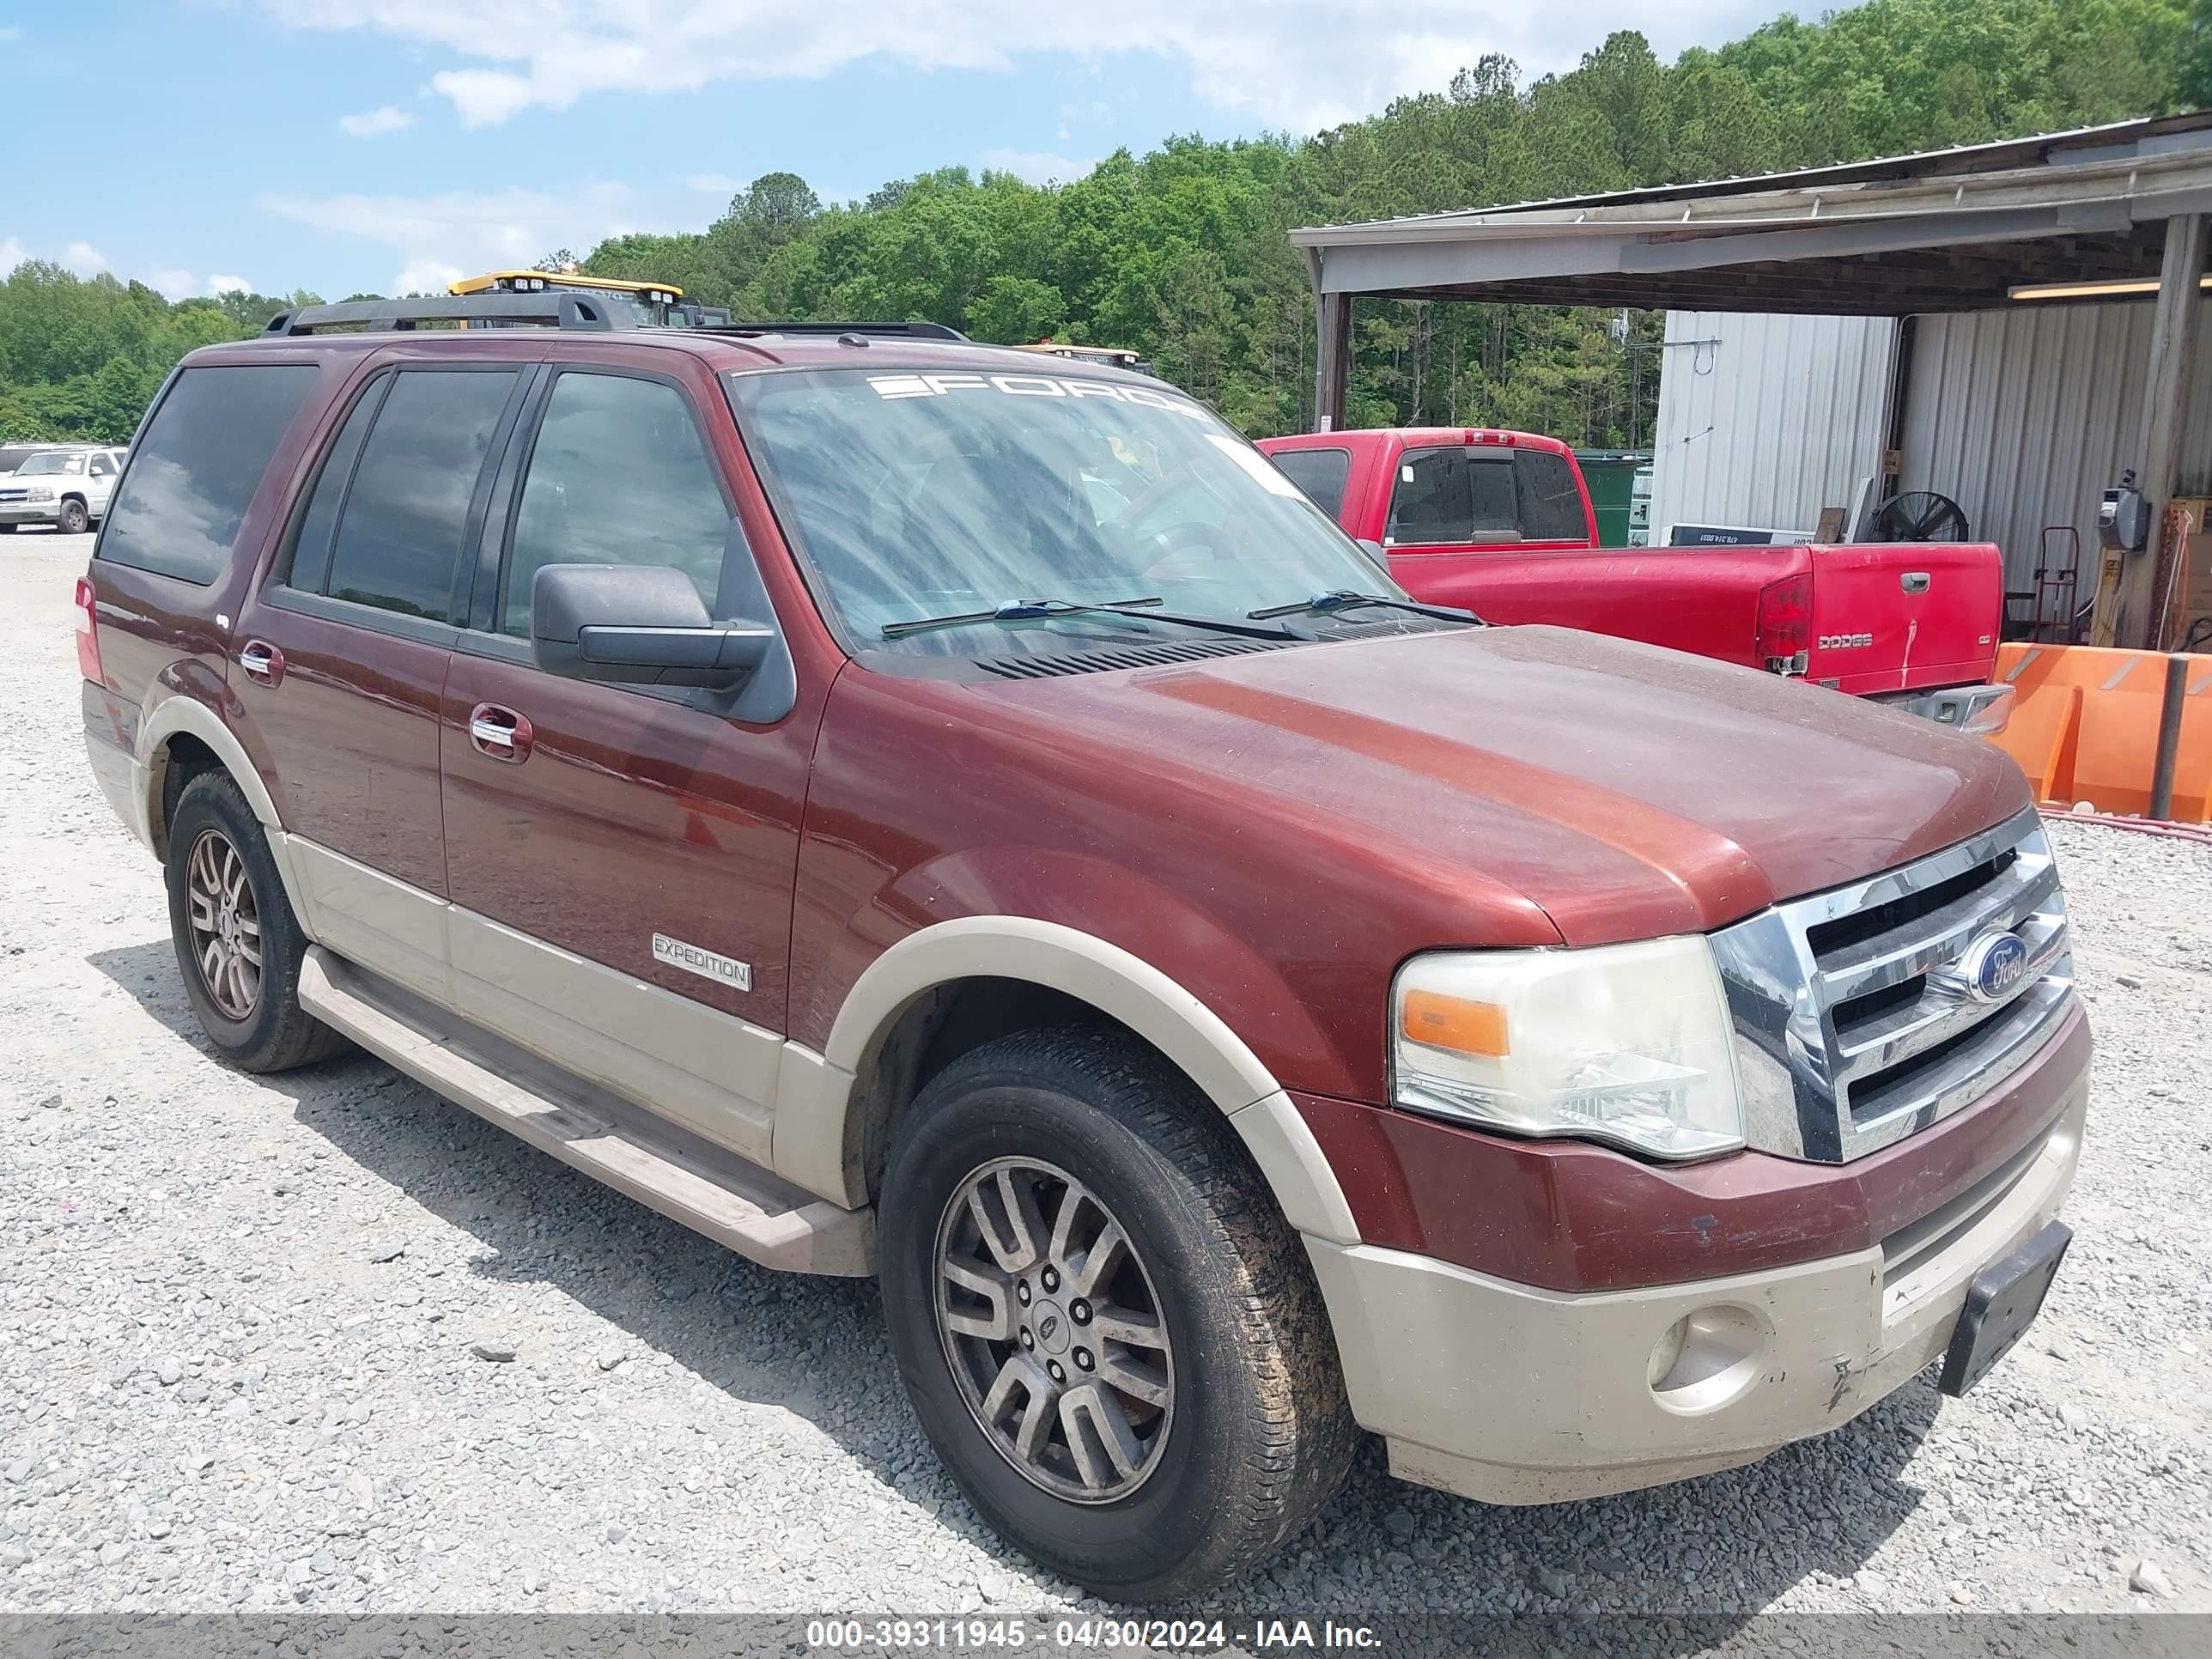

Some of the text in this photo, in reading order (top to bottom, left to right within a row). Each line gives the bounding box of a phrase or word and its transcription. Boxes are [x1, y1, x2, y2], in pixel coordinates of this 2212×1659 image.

[921, 375, 1178, 411] FORD
[1819, 633, 1873, 650] DODGE
[654, 938, 745, 981] EXPEDITION
[1993, 945, 2021, 989] Ford
